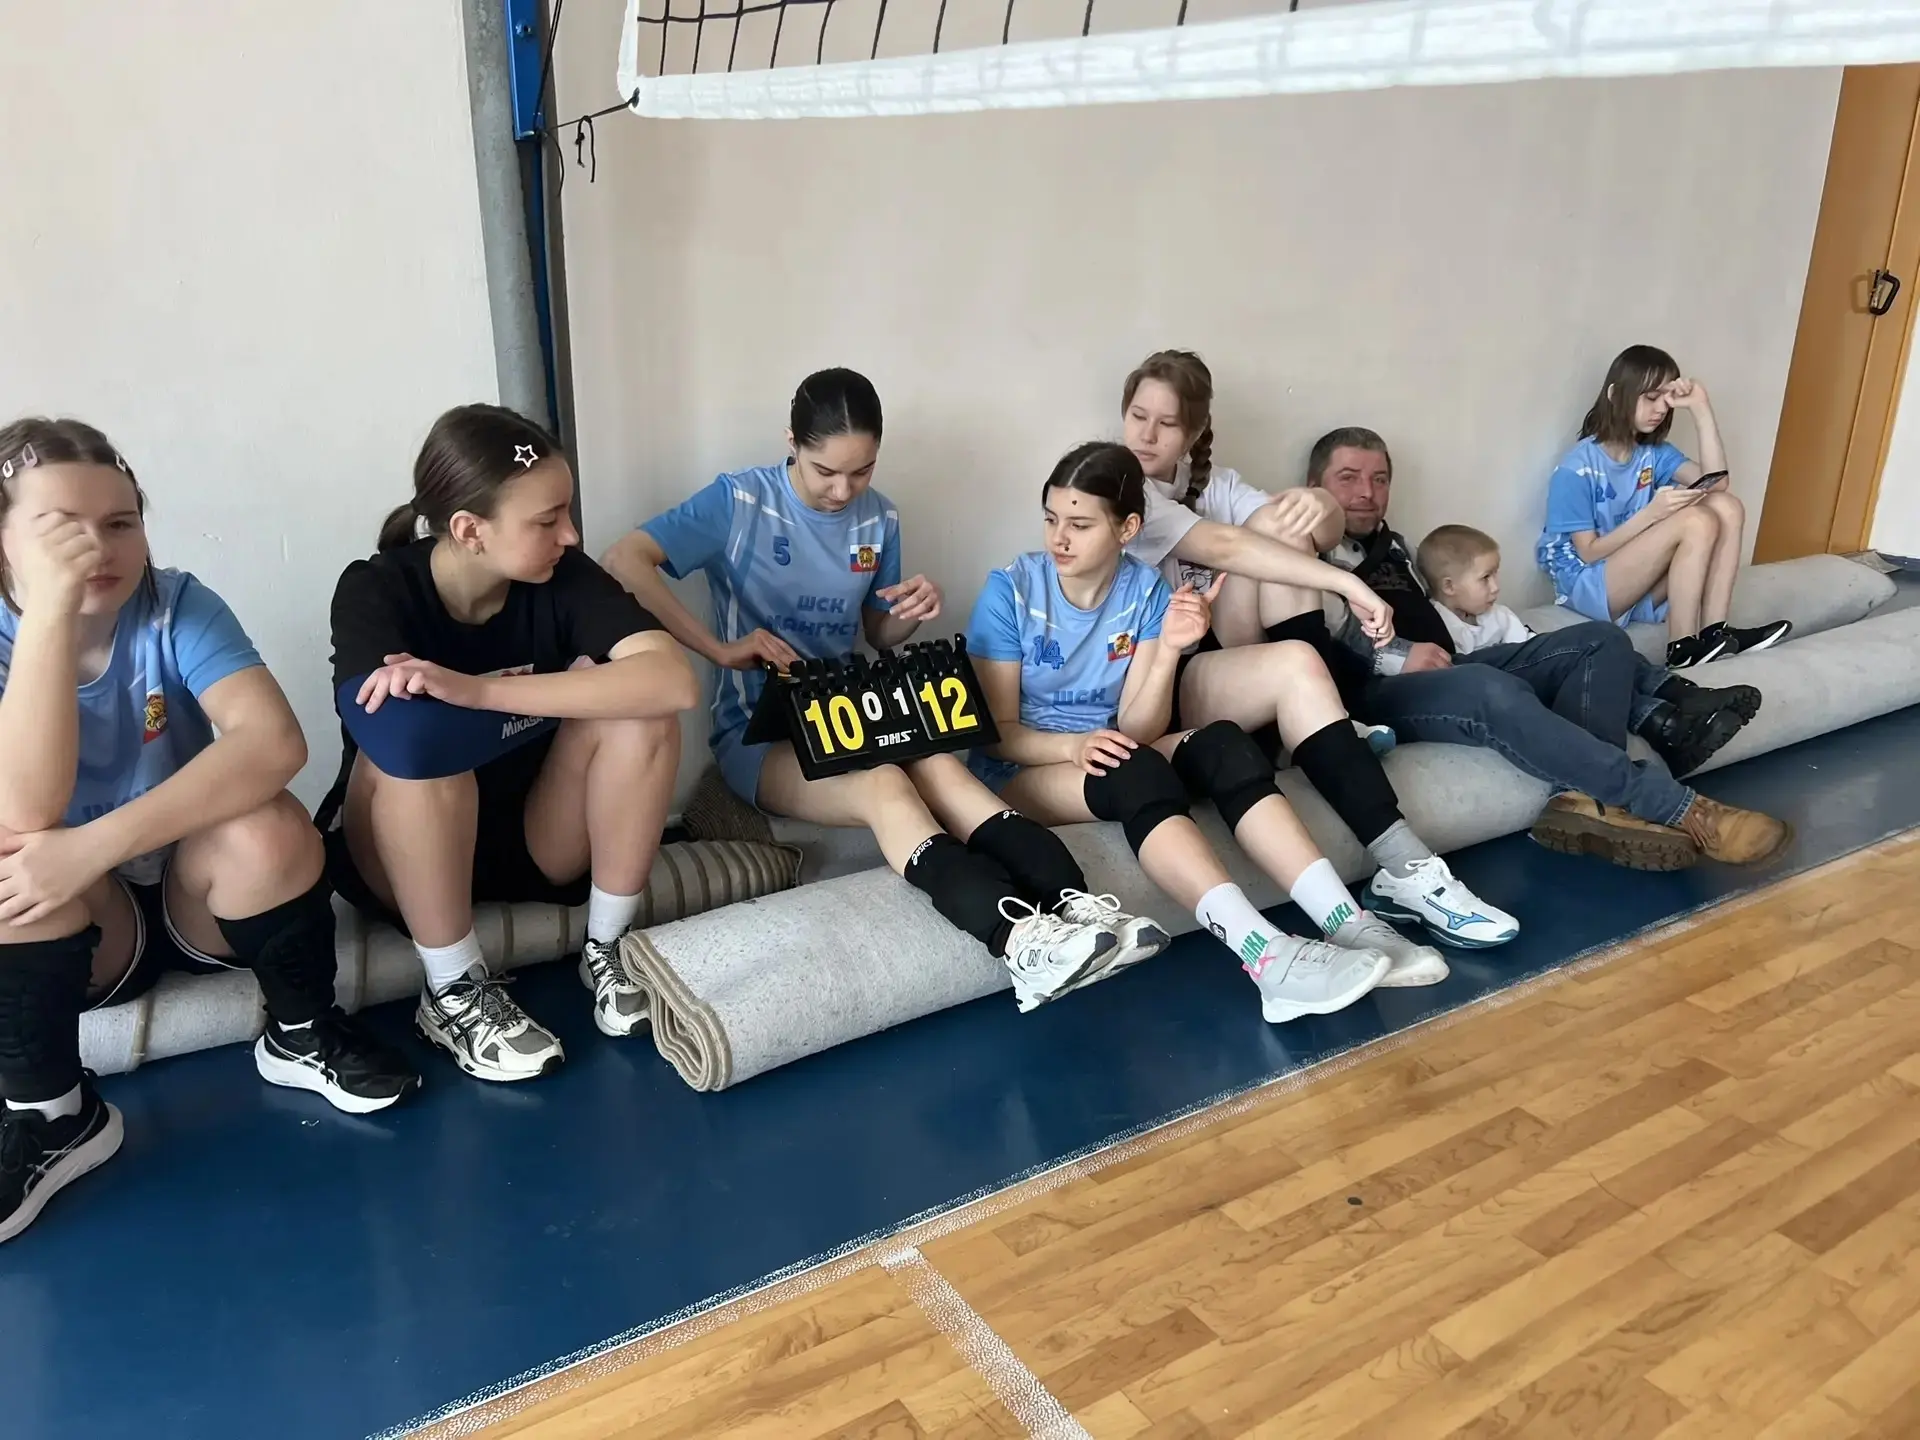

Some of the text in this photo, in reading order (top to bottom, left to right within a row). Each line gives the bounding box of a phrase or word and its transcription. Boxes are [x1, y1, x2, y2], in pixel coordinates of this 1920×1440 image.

[773, 537, 791, 566] 5
[797, 595, 846, 613] ШСК
[1033, 634, 1064, 670] 14
[1053, 687, 1107, 706] ШСК
[804, 677, 979, 754] 10 0 1 12
[875, 730, 913, 747] DHS
